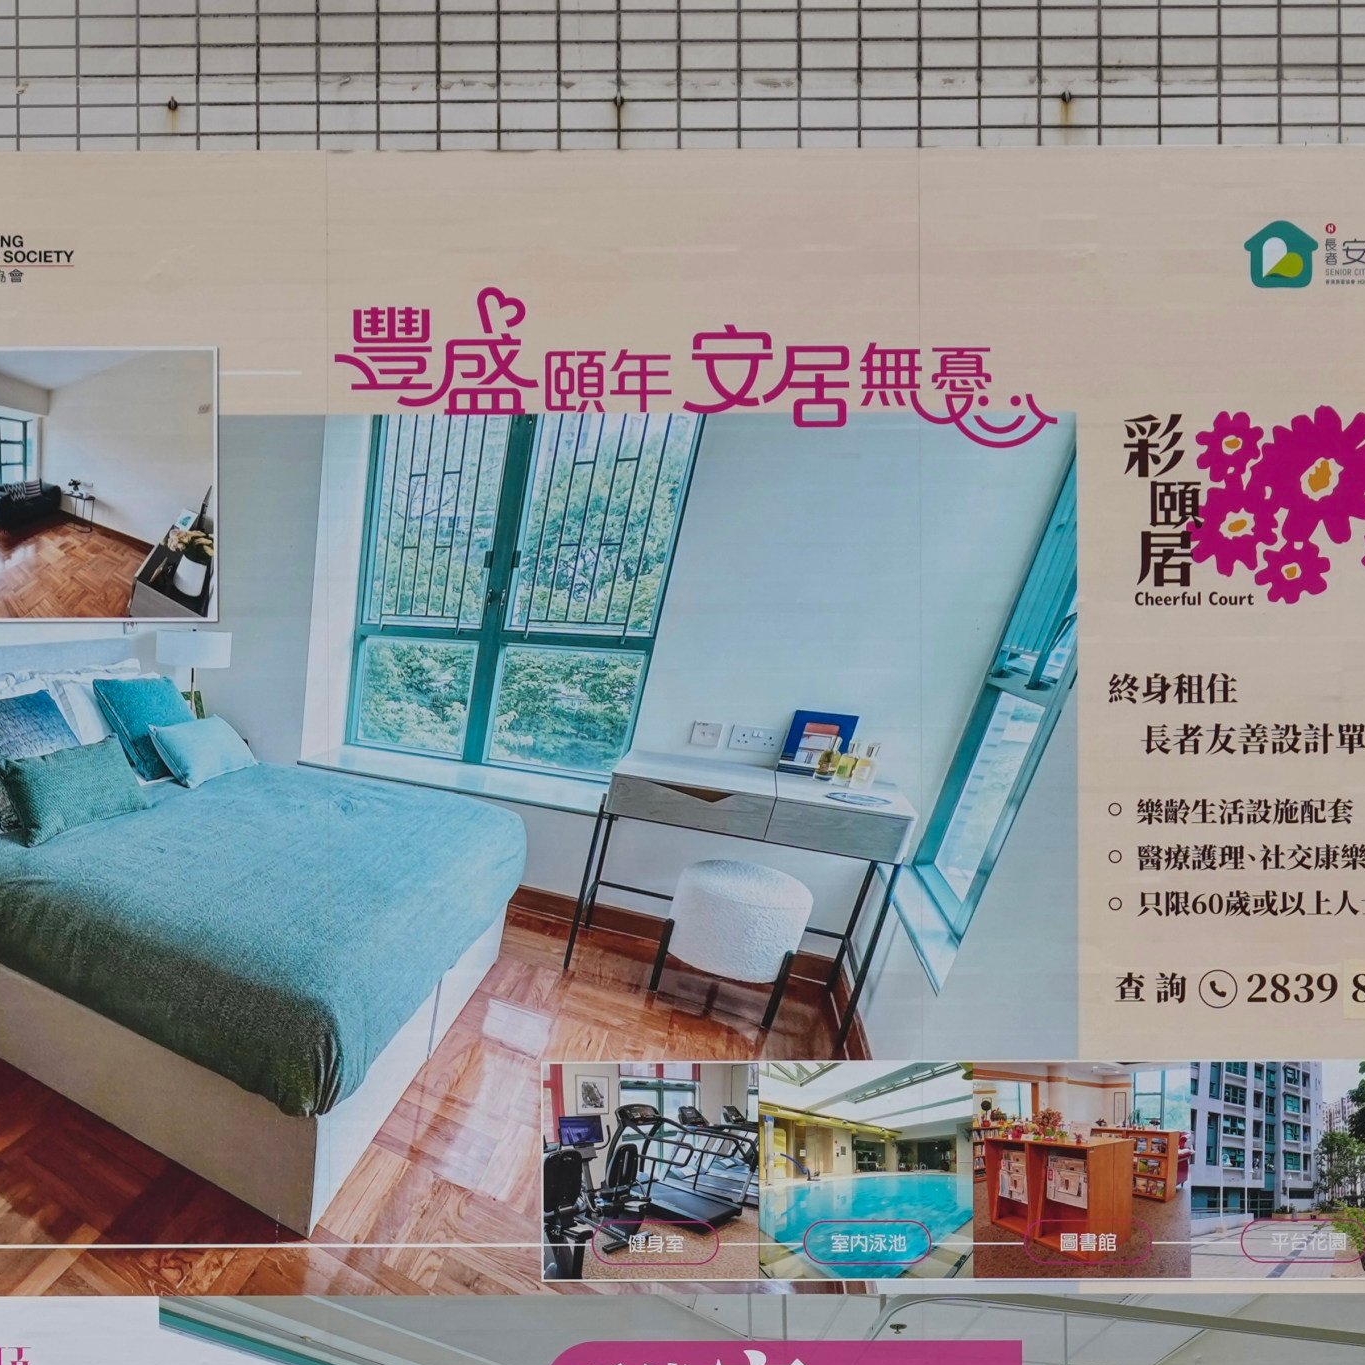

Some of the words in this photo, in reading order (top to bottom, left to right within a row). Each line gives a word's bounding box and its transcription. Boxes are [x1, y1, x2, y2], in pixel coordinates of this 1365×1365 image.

[4, 250, 74, 263] SOCIETY
[1325, 238, 1337, 265] 長者
[1123, 413, 1204, 588] 彩頤居
[1135, 591, 1202, 606] Cheerful
[1209, 592, 1254, 606] Court
[1108, 673, 1238, 705] 終身租住
[1137, 799, 1354, 825] 樂齡生活設施配套
[1114, 972, 1187, 1004] 查詢
[1246, 973, 1339, 1004] 2839
[628, 1234, 684, 1254] 健身室
[1060, 1233, 1117, 1252] 圖書館
[1271, 1233, 1347, 1252] 平台花園
